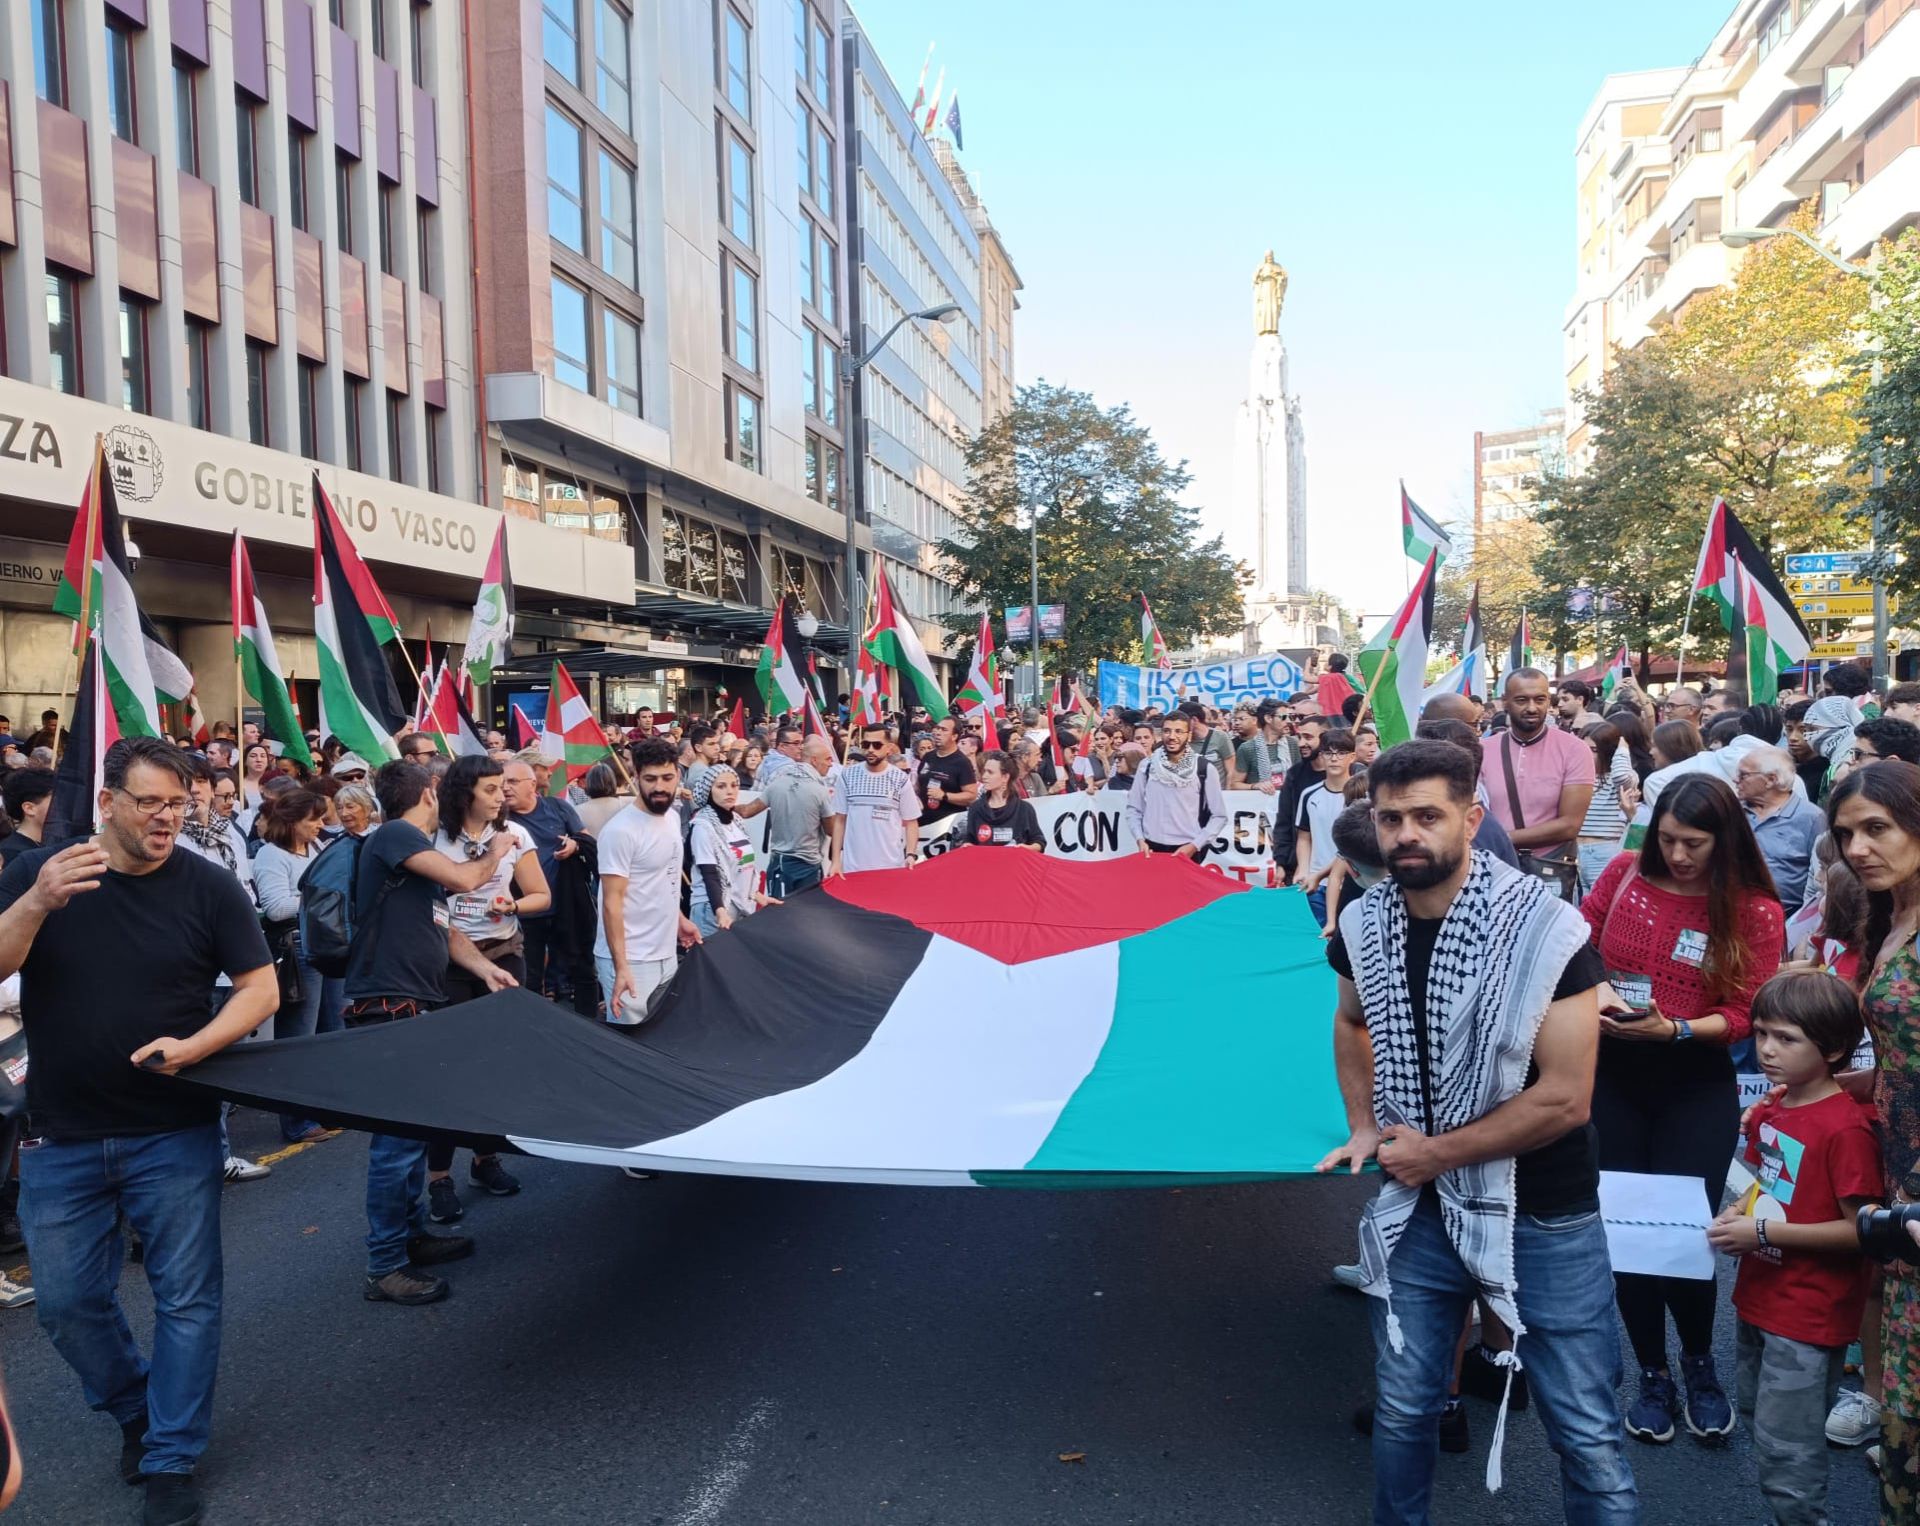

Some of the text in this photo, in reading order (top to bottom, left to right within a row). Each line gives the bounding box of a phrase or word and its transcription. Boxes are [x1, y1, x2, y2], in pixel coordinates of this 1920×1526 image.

[194, 461, 476, 553] GOBIENO VASCO
[1054, 810, 1120, 853] CON
